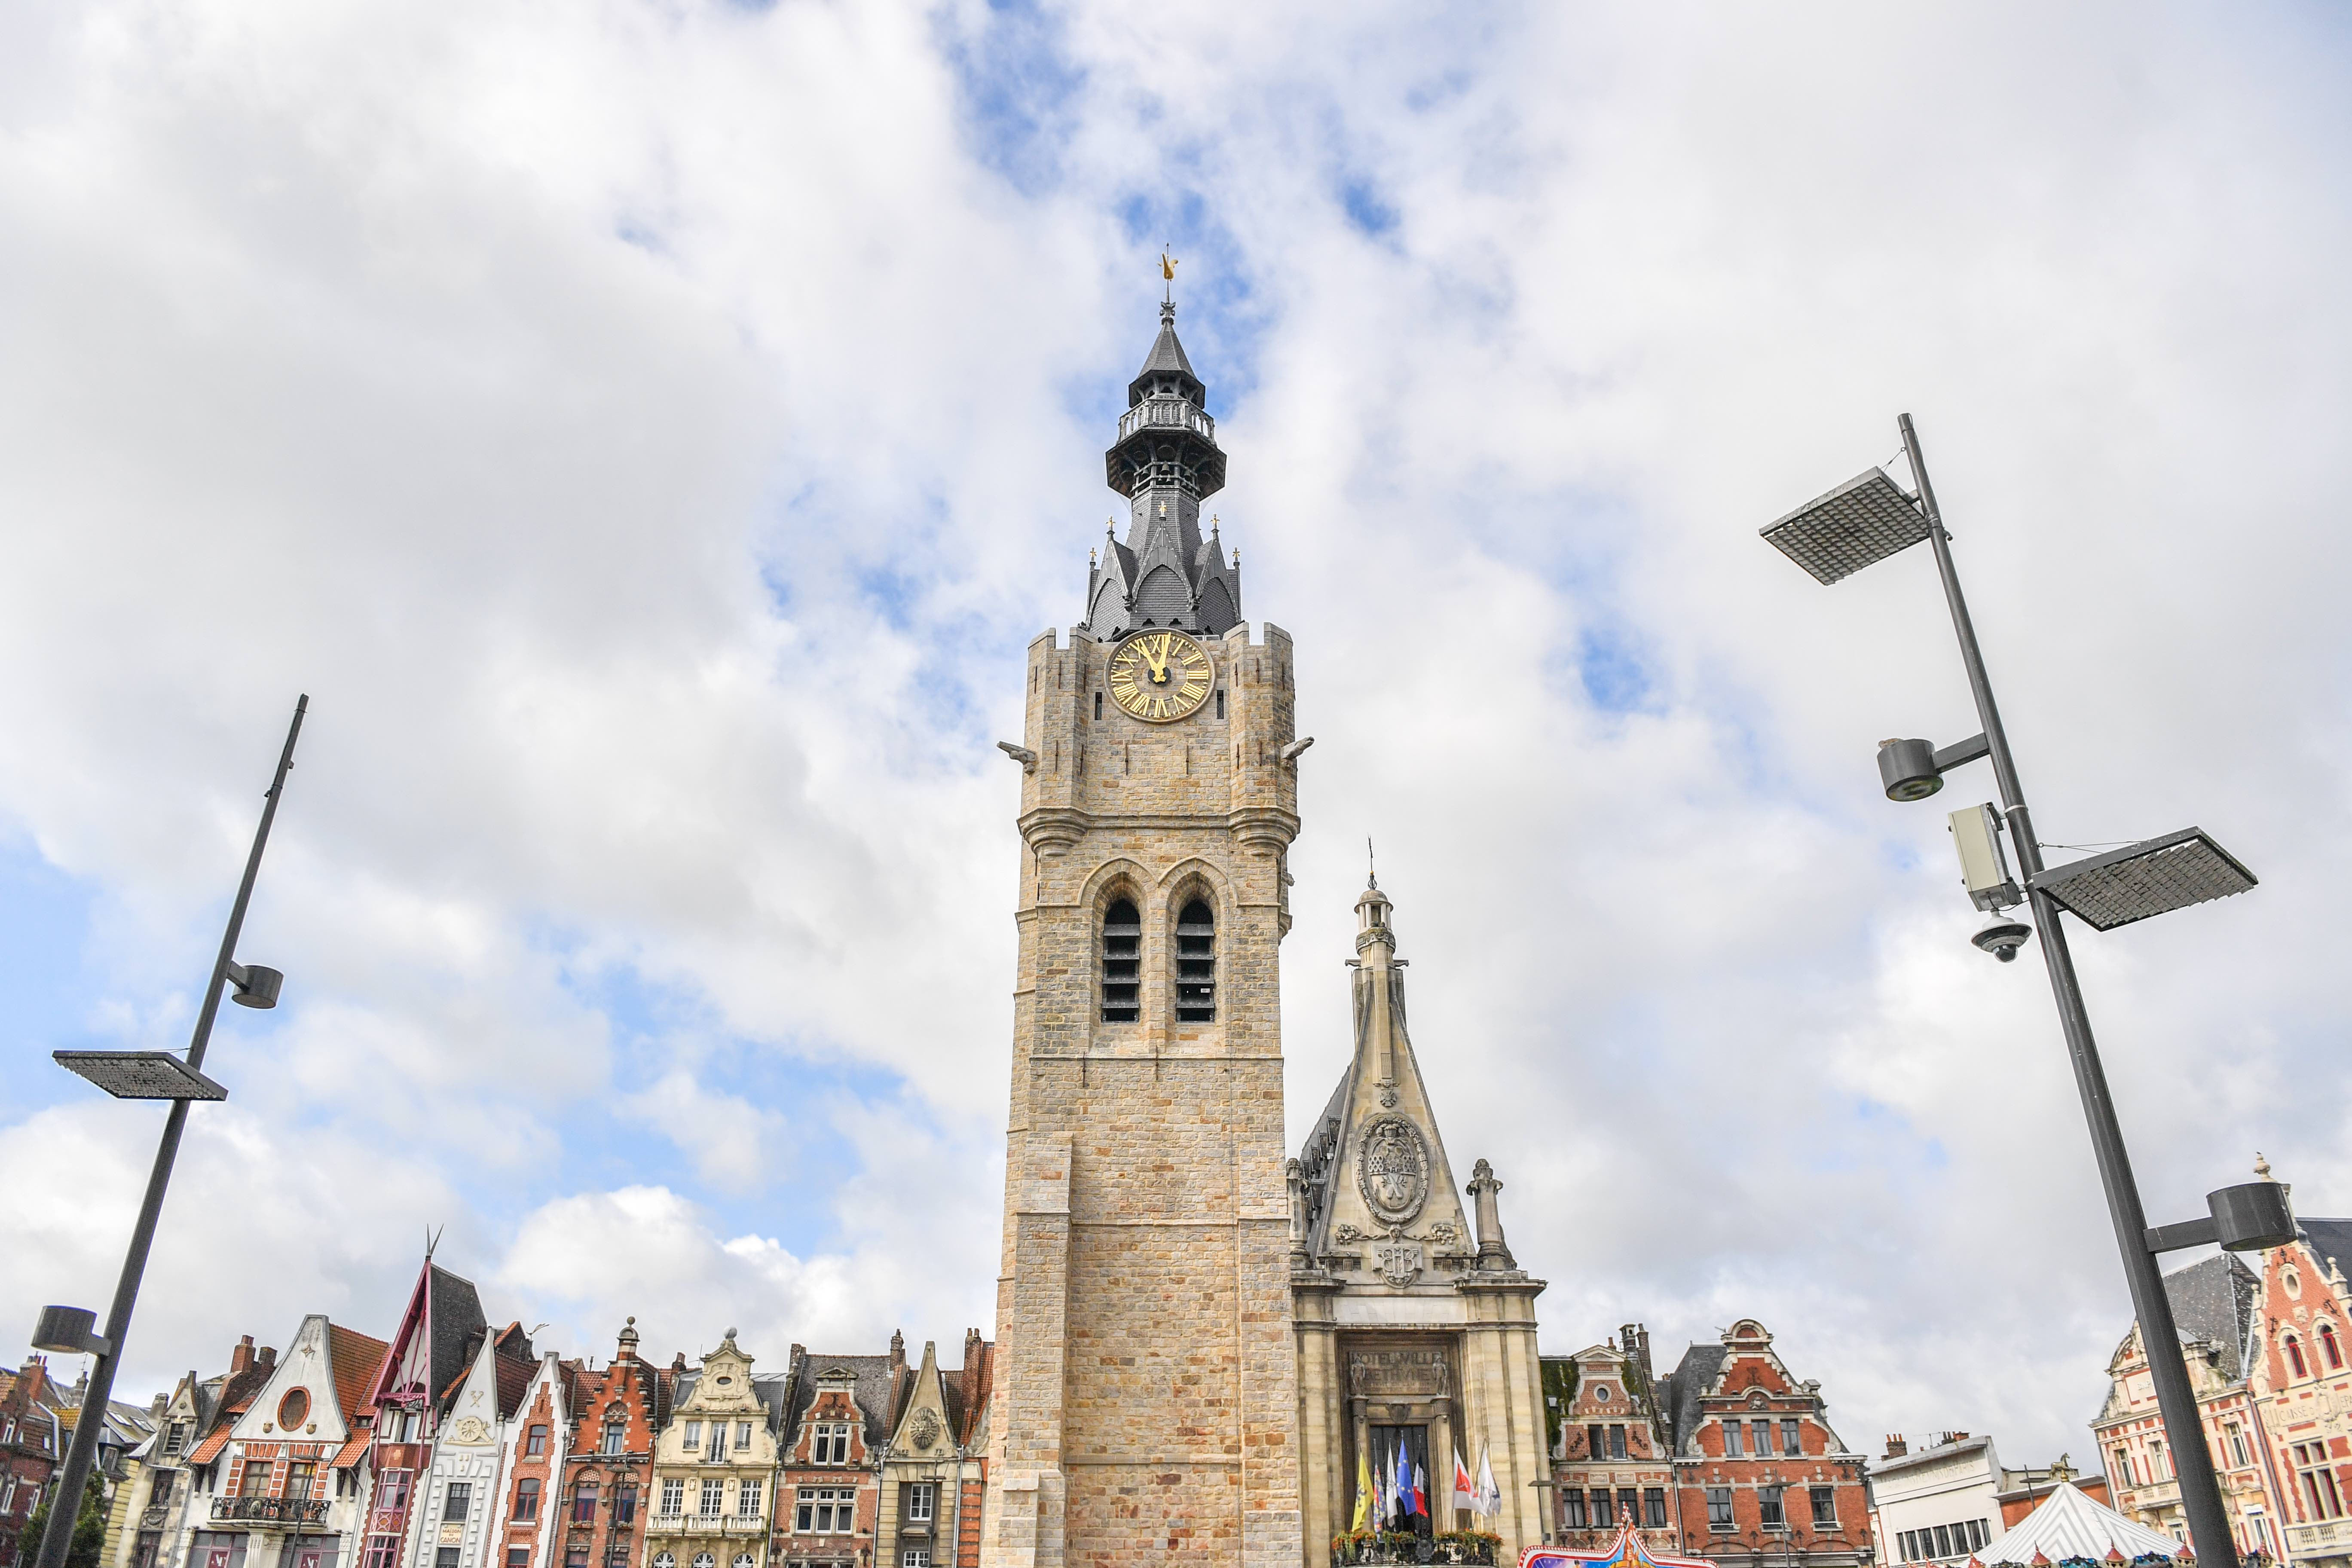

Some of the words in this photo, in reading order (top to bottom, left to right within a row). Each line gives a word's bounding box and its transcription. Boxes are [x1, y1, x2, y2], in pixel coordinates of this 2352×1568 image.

[1171, 639, 1185, 656] I
[1115, 651, 1139, 668] X
[1181, 651, 1204, 666] II
[1111, 669, 1133, 682] IX
[1187, 669, 1208, 680] III
[1113, 682, 1139, 705] VIII
[1180, 682, 1206, 700] IIII
[1129, 693, 1150, 715] VII
[1154, 698, 1168, 718] VI
[1172, 694, 1192, 714] V
[2279, 1406, 2308, 1422] CAISSE
